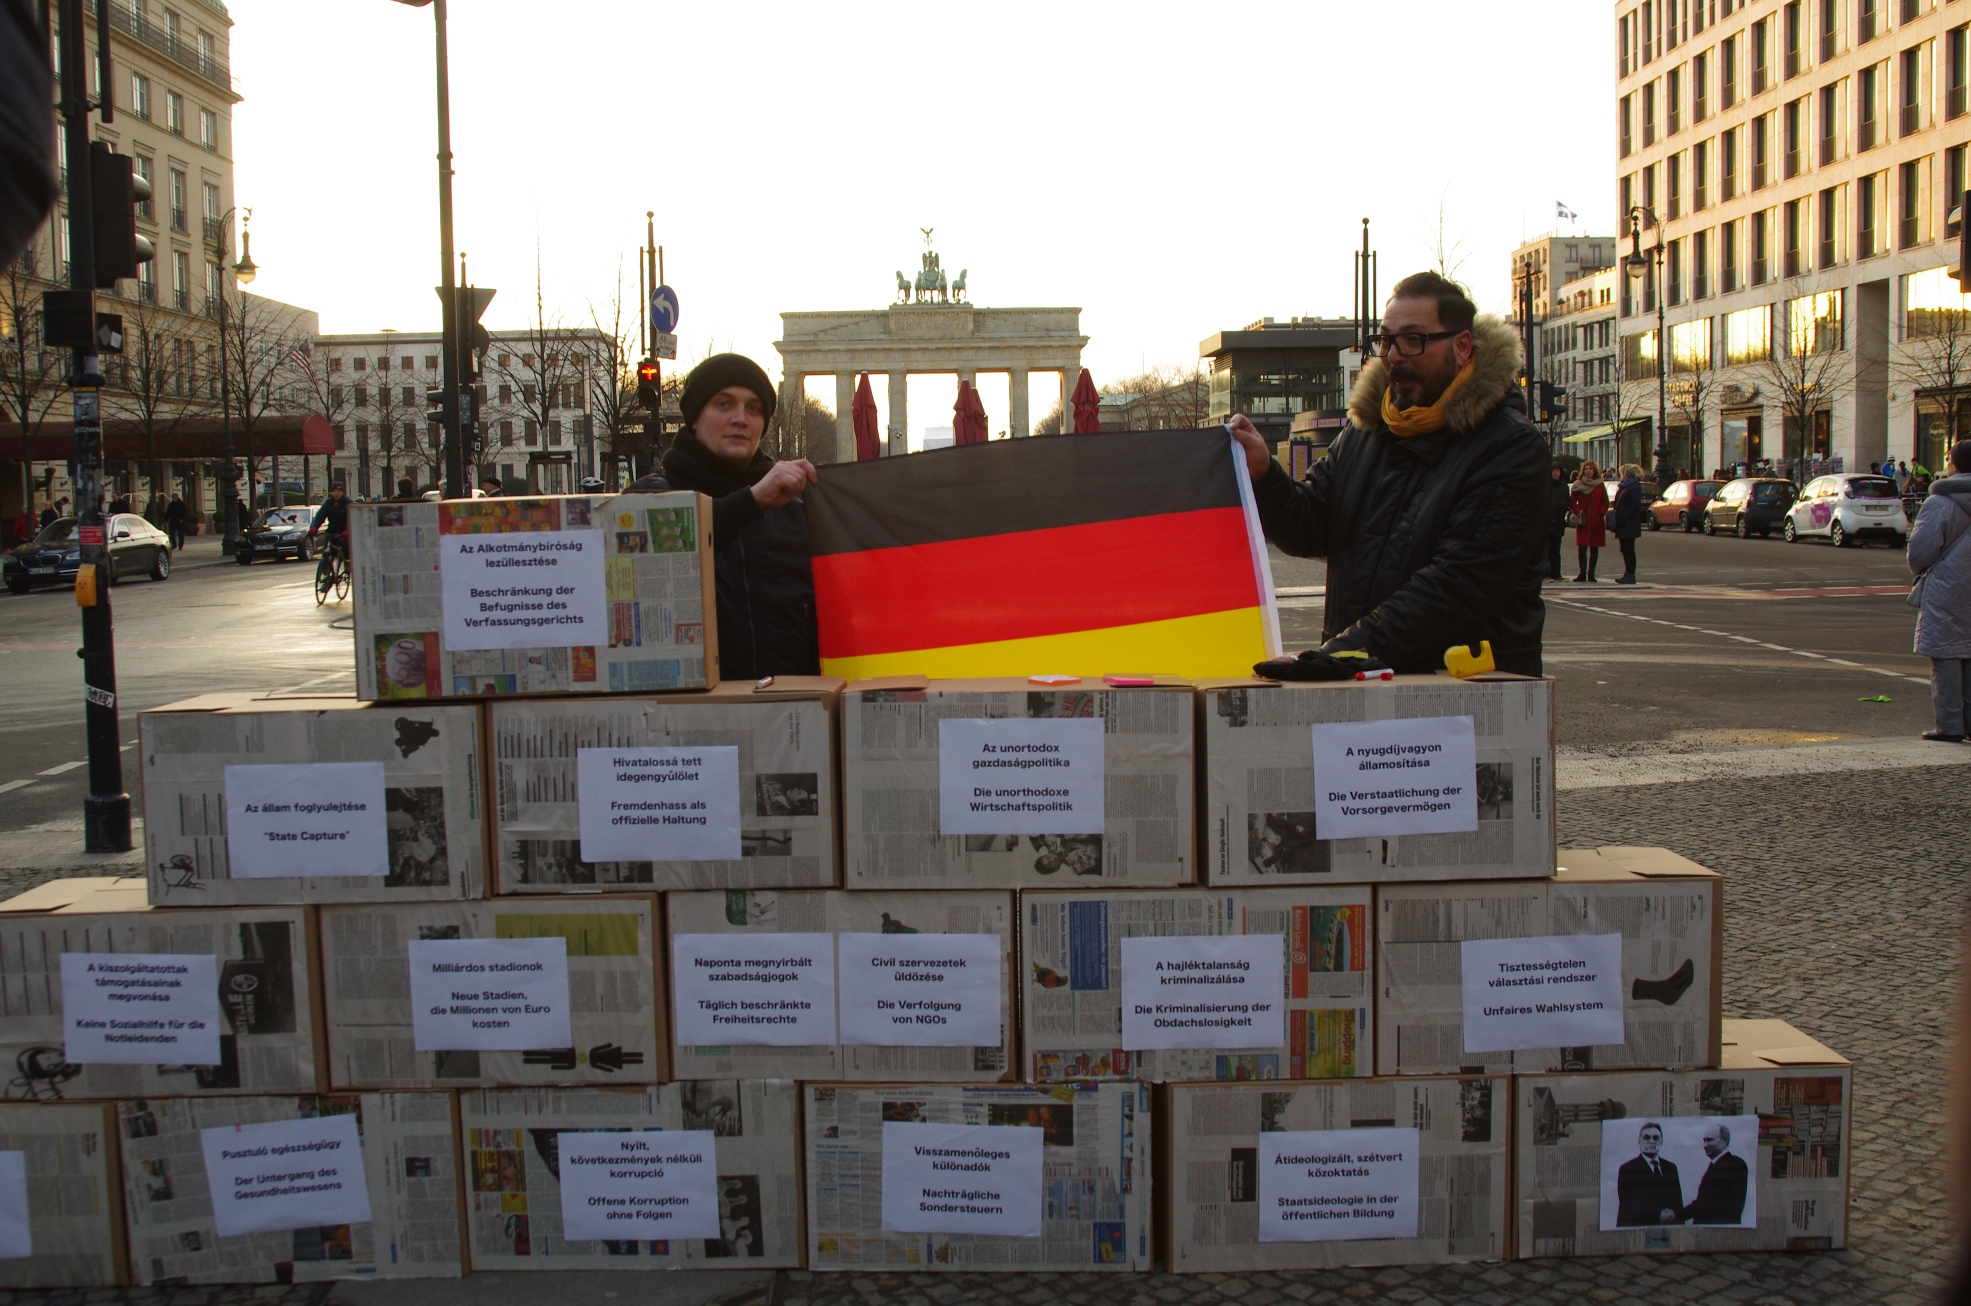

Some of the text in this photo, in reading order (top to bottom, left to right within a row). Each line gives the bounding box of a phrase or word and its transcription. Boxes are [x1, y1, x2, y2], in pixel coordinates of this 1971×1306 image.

[460, 541, 582, 553] Az Alkotmánybíróság
[486, 556, 557, 567] lezüllesztése
[470, 586, 575, 597] Beschränkung der
[480, 601, 567, 613] Befugnisse des
[464, 615, 584, 627] Verfassungsgerichts
[983, 743, 1059, 752] Az unortodox
[1346, 744, 1441, 757] A nyugdíjvagyon
[613, 757, 702, 767] Hivatalossá tett
[973, 758, 1069, 769] gazdaságpolitika
[1359, 758, 1430, 770] államosítása
[617, 771, 699, 783] idegengyűlölet
[974, 788, 1069, 796] Die unorthodoxe
[1329, 786, 1462, 801] Die Verstaatlichung der
[245, 802, 366, 813] Az állam foglyulejtése
[611, 801, 706, 810] Fremdenhass als
[970, 802, 1073, 812] Wirtschaftspolitik
[1341, 802, 1450, 815] Vorsorgevermögen
[612, 816, 706, 825] offizielle Haltung
[1294, 910, 1302, 948] Robin Look
[432, 962, 543, 972] Milliárdos stadionok
[695, 957, 812, 968] Naponta megnyirbált
[872, 958, 966, 967] Civil szervezetek
[1156, 960, 1249, 971] A hajléktalanság
[1498, 959, 1585, 972] Tisztességtelen
[87, 963, 188, 974] A kiszolgáltatottak
[709, 972, 798, 982] szabadságjogok
[895, 972, 944, 981] üldözése
[1161, 974, 1244, 985] kriminalizálása
[1489, 974, 1597, 987] választási rendszer
[95, 977, 182, 988] támogatásainak
[108, 992, 170, 1002] megvonása
[452, 991, 527, 1000] Neue Stadien,
[430, 1006, 447, 1015] die
[450, 1006, 498, 1014] Millionen
[524, 1004, 550, 1013] Euro
[698, 1000, 811, 1011] Täglich beschränkte
[878, 1000, 961, 1011] Die Verfolgung
[1135, 1003, 1271, 1014] Die Kriminalisierung der
[1484, 1002, 1603, 1016] Unfaires Wahlsystem
[76, 1019, 205, 1029] Keine Sozialhilfe für die
[472, 1020, 510, 1028] kosten
[713, 1015, 797, 1024] Freiheitsrechte
[916, 1015, 946, 1024] NGOs
[1154, 1017, 1251, 1028] Obdachslosigkeit
[105, 1034, 177, 1043] Notleidenden
[1342, 1011, 1354, 1065] Shopping
[222, 1140, 341, 1159] Pusztuló egészségügy
[621, 1141, 649, 1152] Nyílt,
[914, 1146, 1011, 1159] Visszamenőleges
[571, 1154, 702, 1165] következmények nélküli
[1275, 1153, 1402, 1165] Átideologizált, szétvert
[933, 1161, 990, 1172] különadók
[1308, 1167, 1369, 1177] közoktatás
[235, 1168, 338, 1188] Der Untergang des
[610, 1168, 664, 1179] korrupció
[234, 1179, 342, 1200] Gesundheitswesens
[922, 1188, 1000, 1200] Nachträgliche
[588, 1196, 689, 1206] Offene Korruption
[1278, 1195, 1399, 1206] Staatsideologie in der
[920, 1202, 1002, 1214] Sondersteuern
[606, 1210, 672, 1220] ohne Folgen
[1282, 1209, 1394, 1220] öffentlichen Bildung
